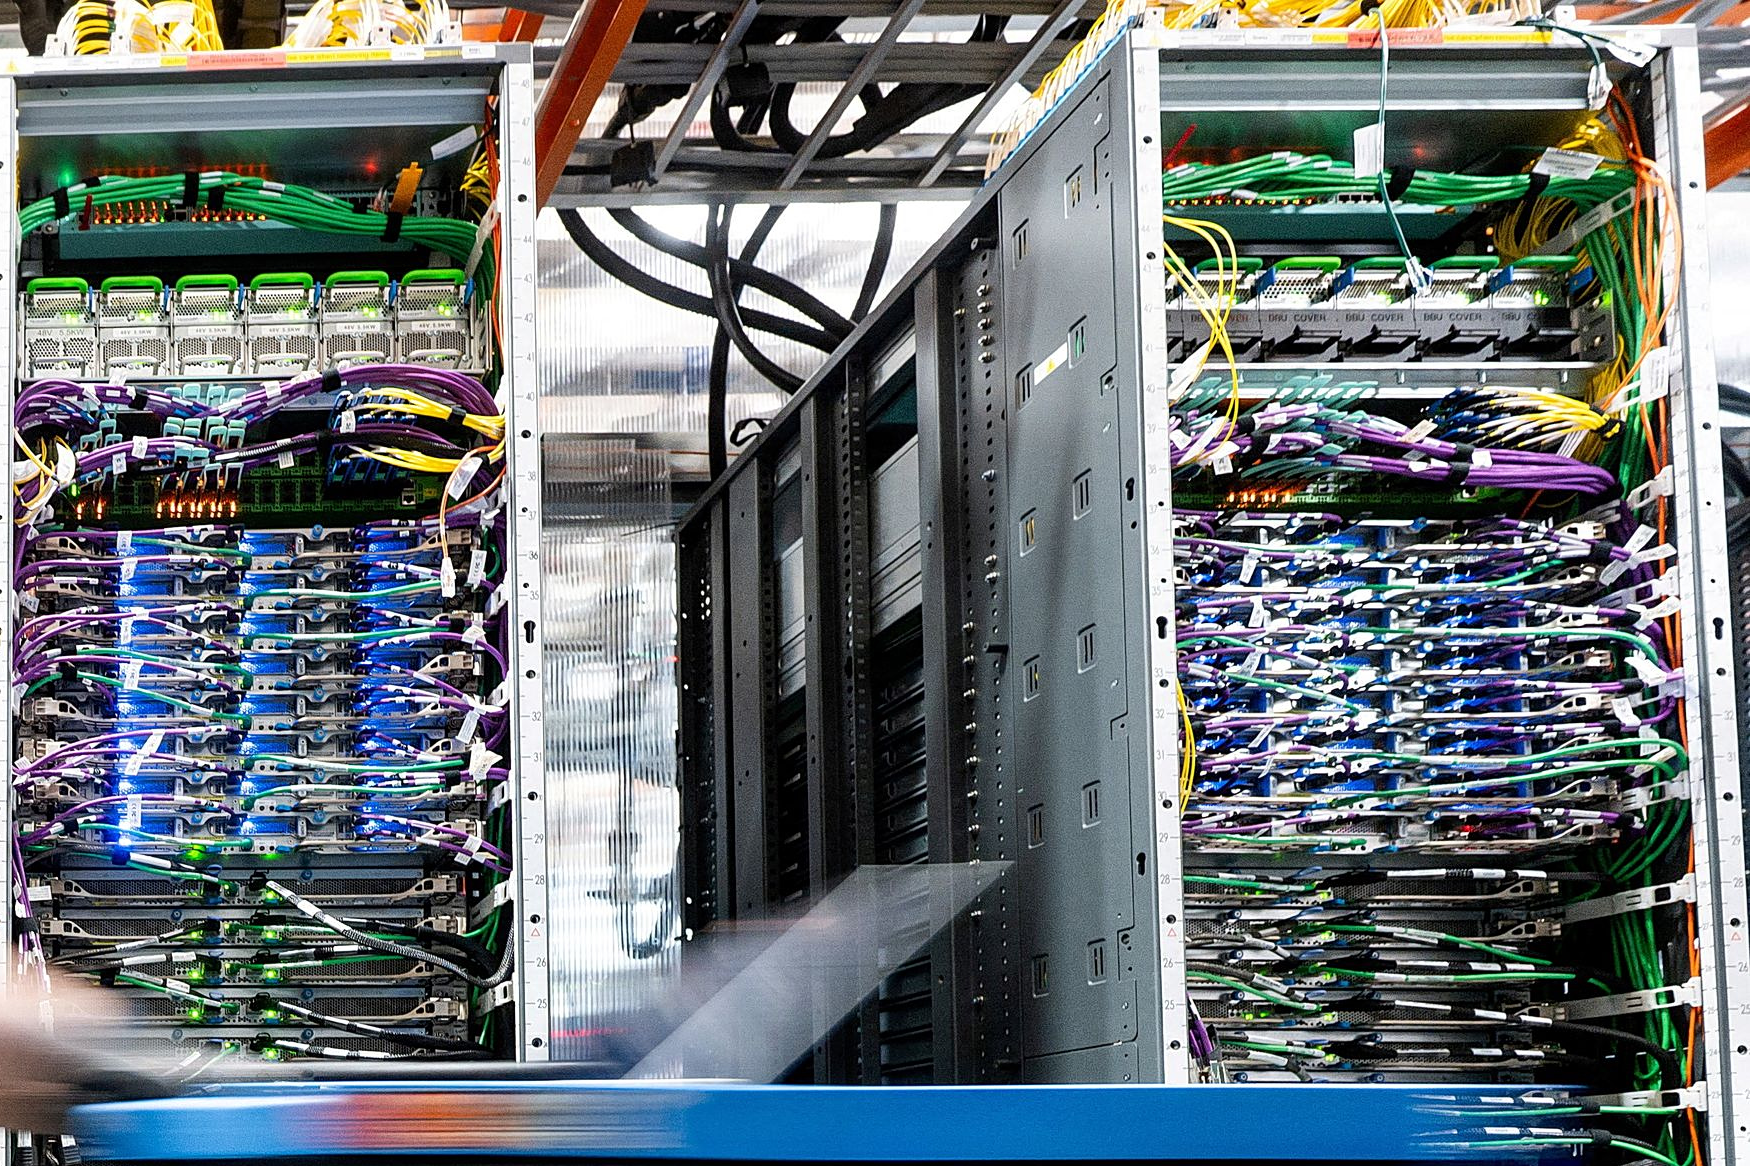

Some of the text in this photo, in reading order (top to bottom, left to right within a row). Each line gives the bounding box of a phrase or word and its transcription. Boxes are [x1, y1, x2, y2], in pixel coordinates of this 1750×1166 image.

[522, 157, 532, 166] 46
[523, 234, 532, 245] 44
[524, 273, 532, 283] 43
[524, 312, 534, 323] 42
[526, 352, 535, 362] 41
[526, 392, 535, 402] 40
[528, 471, 536, 481] 38
[527, 511, 537, 521] 37
[529, 551, 538, 560] 36
[530, 590, 540, 600] 35
[532, 711, 544, 721] 32
[534, 752, 542, 762] 31
[1156, 749, 1164, 760] 31
[534, 833, 544, 844] 29
[1159, 832, 1168, 843] 29
[1731, 835, 1741, 846] 29
[534, 874, 545, 885] 28
[1160, 873, 1170, 885] 28
[1733, 877, 1744, 888] 28
[536, 957, 546, 968] 26
[1163, 957, 1174, 968] 26
[1738, 962, 1748, 972] 26
[537, 998, 548, 1009] 25
[1164, 999, 1175, 1010] 25
[1740, 1004, 1750, 1015] 25
